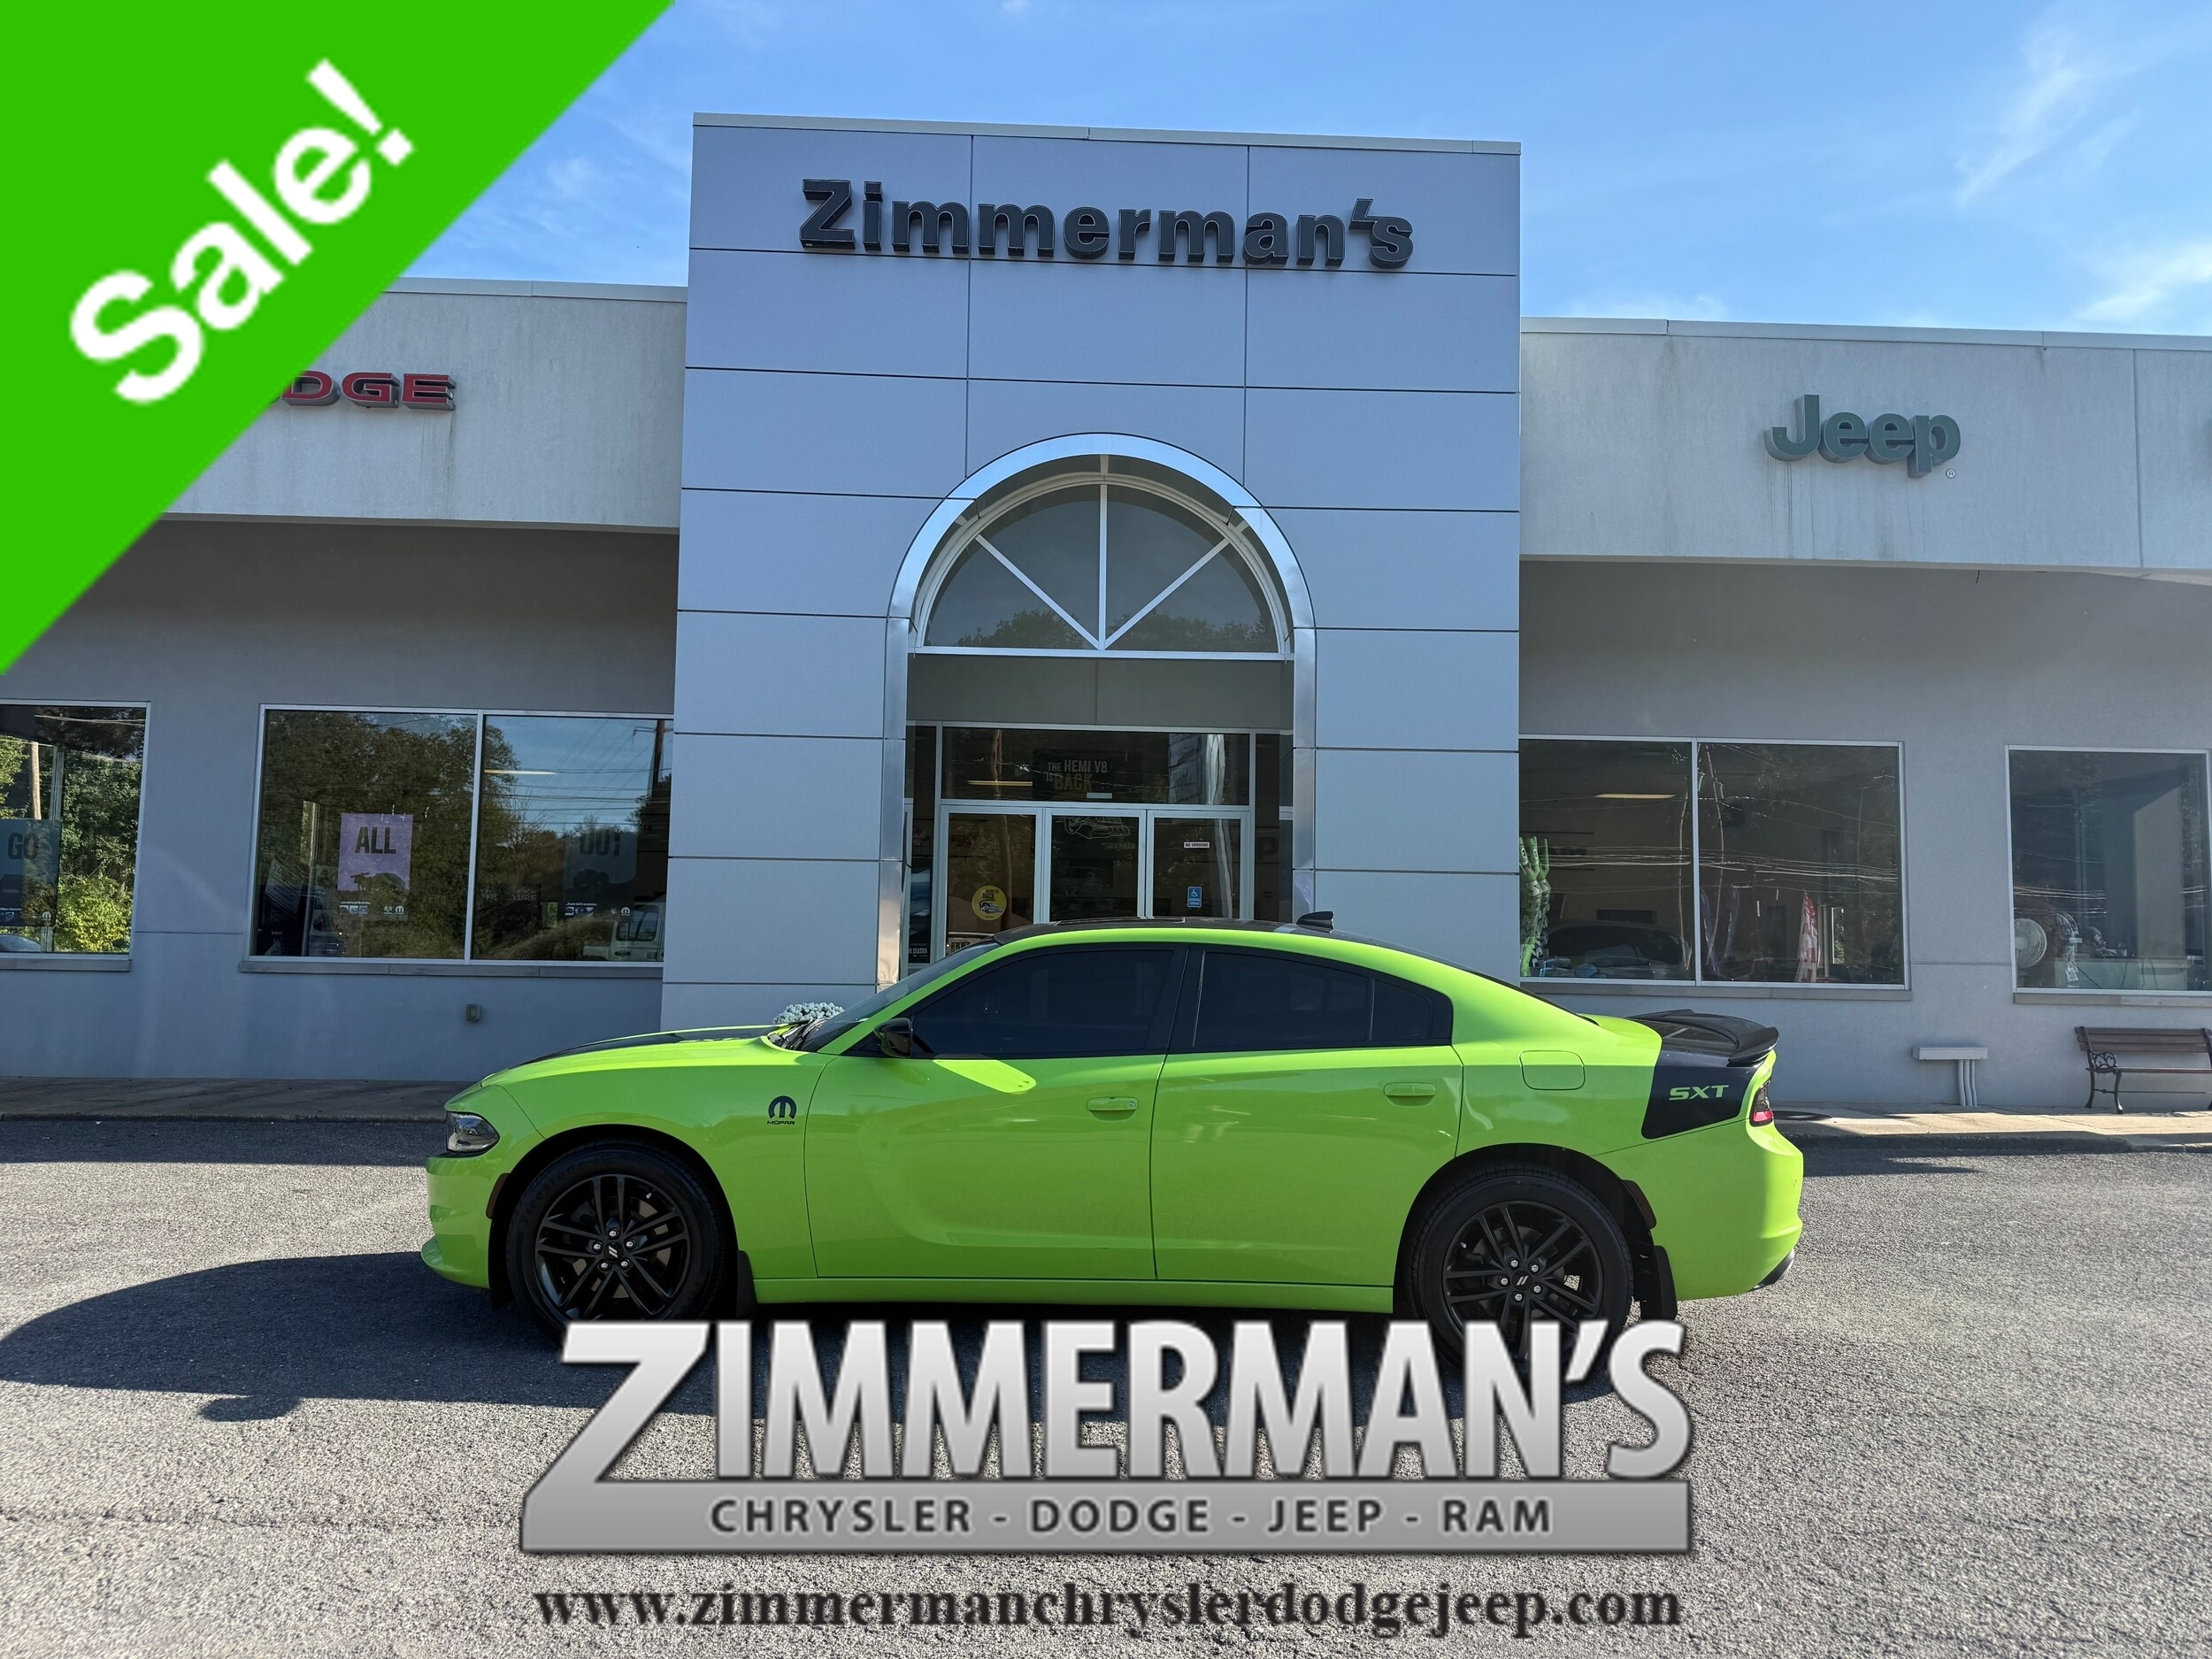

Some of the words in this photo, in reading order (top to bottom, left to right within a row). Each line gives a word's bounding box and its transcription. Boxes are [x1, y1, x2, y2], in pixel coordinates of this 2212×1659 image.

[799, 179, 1415, 269] Zimmerman's
[269, 370, 457, 411] DGE
[1764, 394, 1961, 478] Jeep
[1048, 762, 1063, 772] THE
[1064, 759, 1092, 773] HEMI
[1094, 760, 1108, 774] V8
[1054, 772, 1094, 791] BACK
[7, 832, 38, 860] GO
[354, 826, 397, 855] ALL
[1669, 1085, 1730, 1101] SXT
